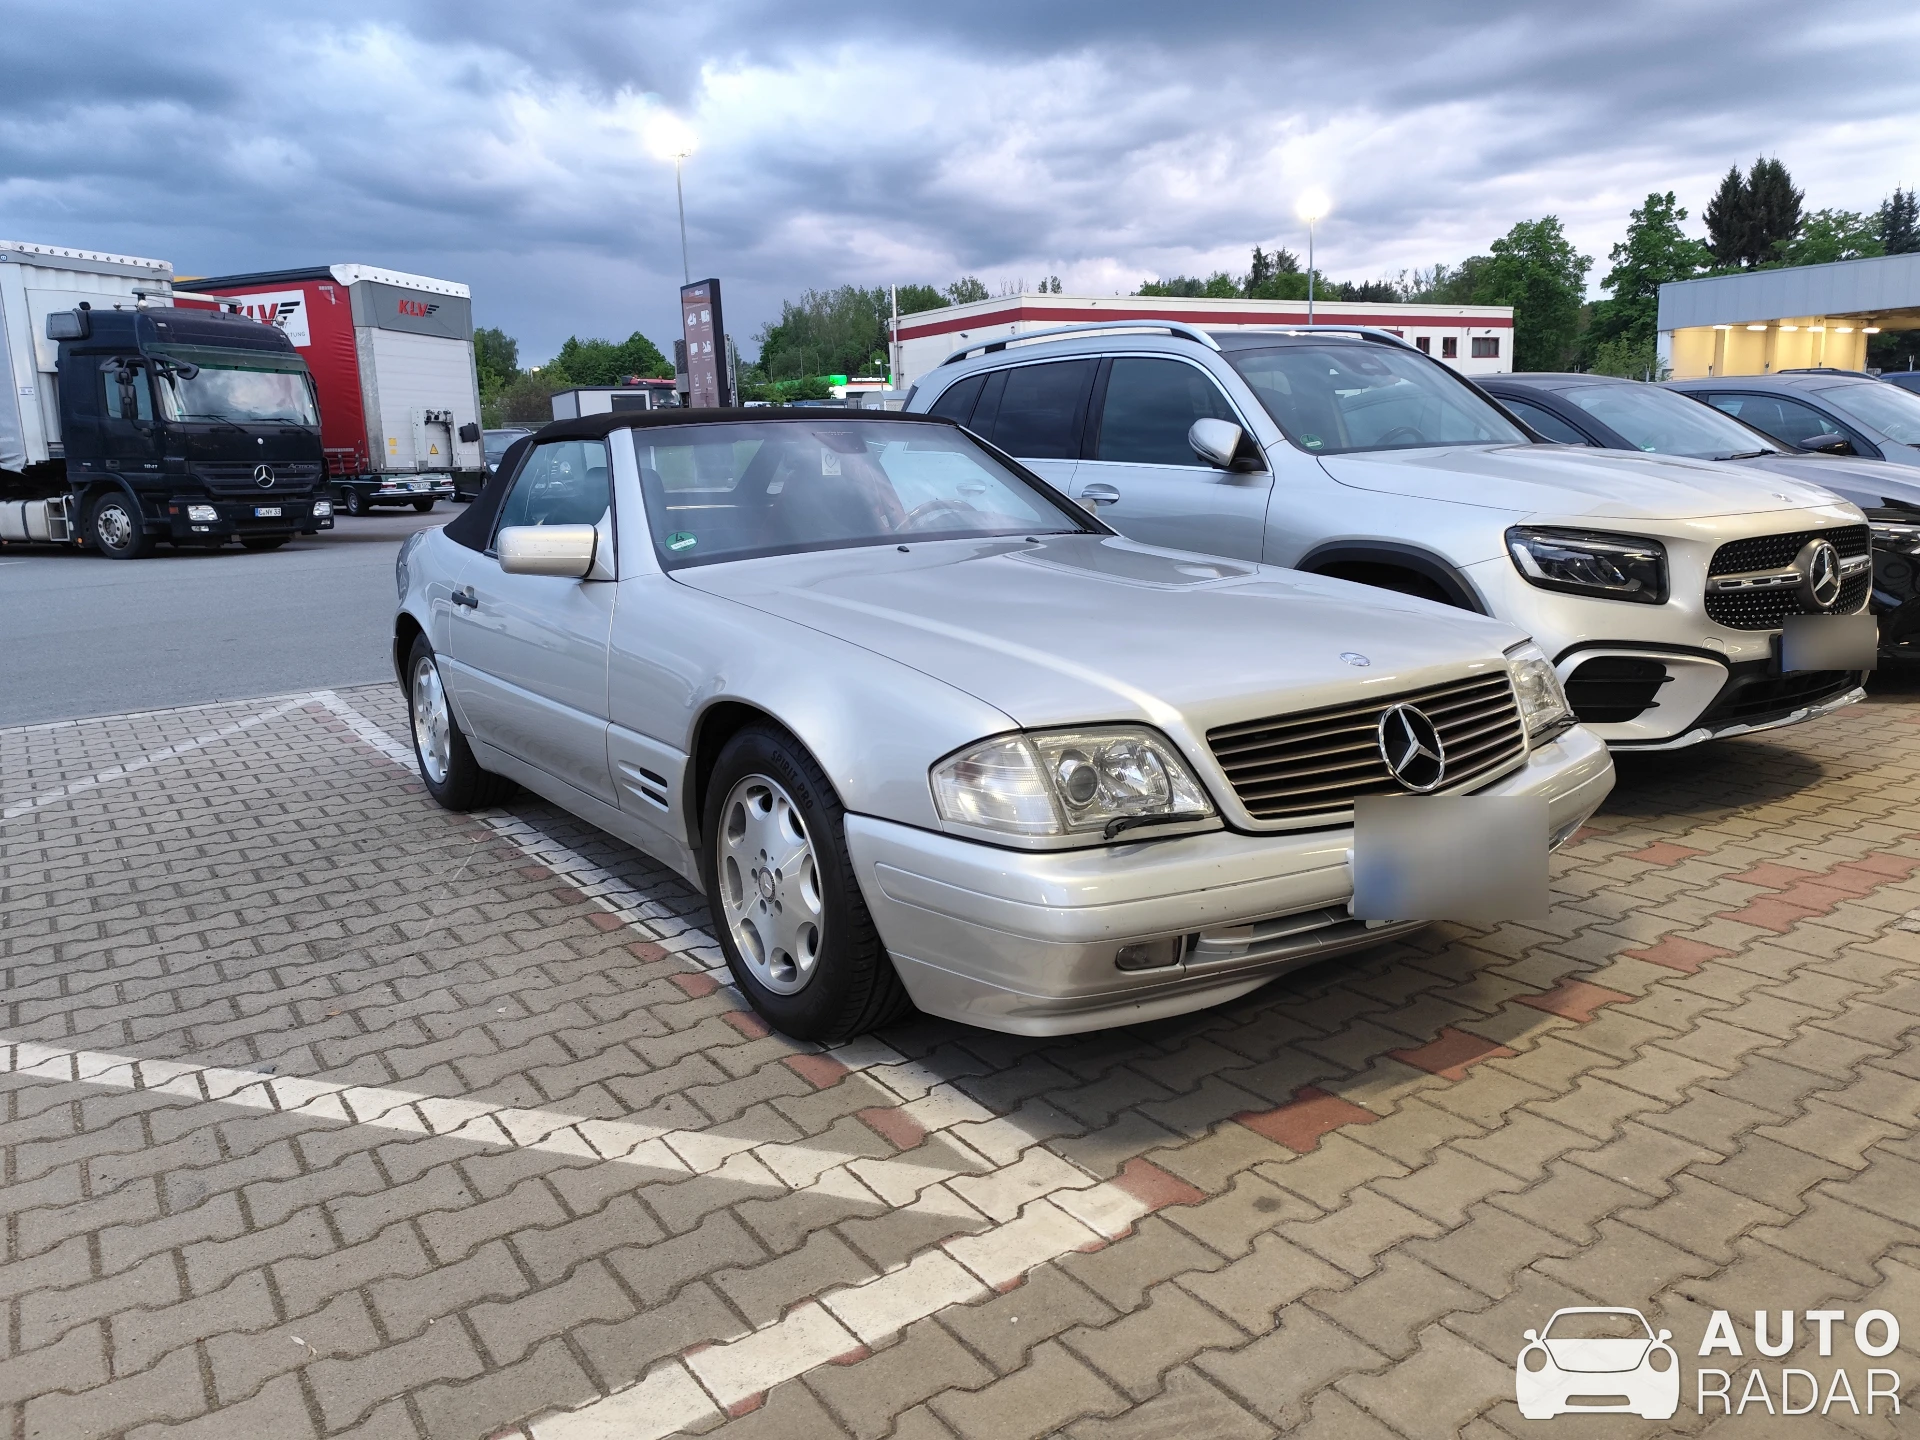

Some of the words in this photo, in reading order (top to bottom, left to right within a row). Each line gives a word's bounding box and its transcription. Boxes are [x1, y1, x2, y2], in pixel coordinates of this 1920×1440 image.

[398, 299, 428, 317] KLV
[675, 533, 685, 542] 4
[770, 750, 798, 781] SPIRIT
[796, 782, 813, 810] PRO
